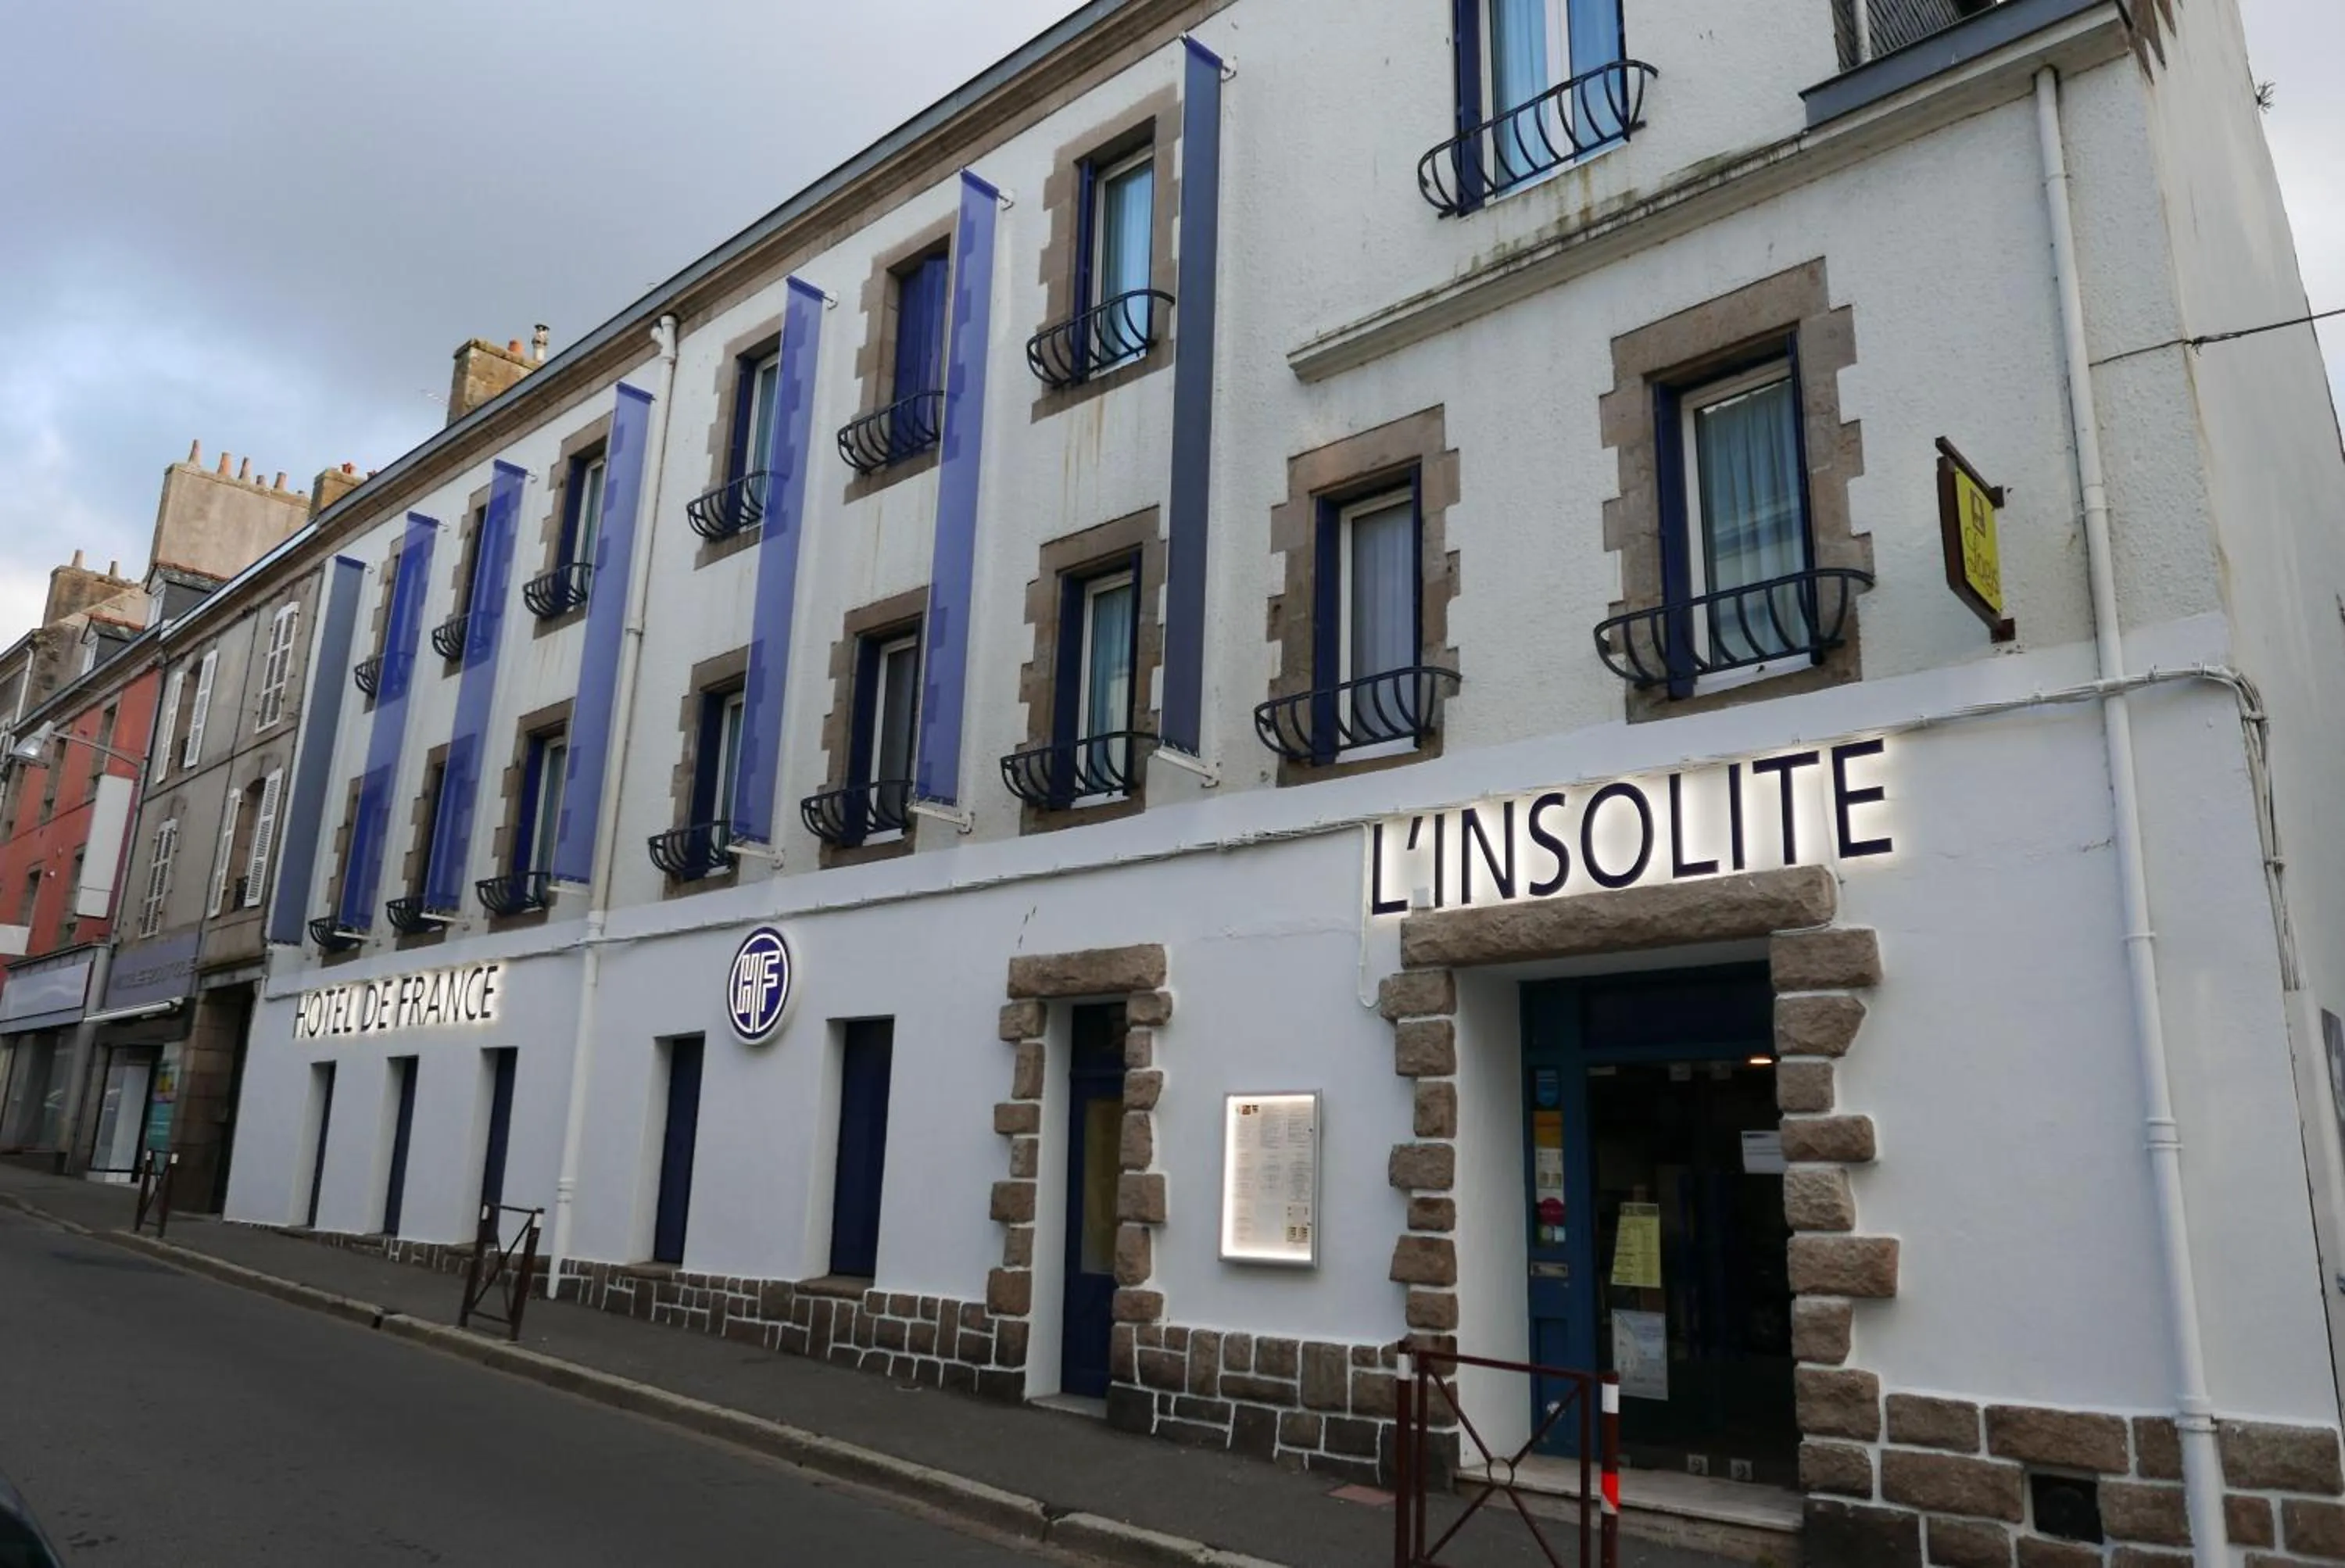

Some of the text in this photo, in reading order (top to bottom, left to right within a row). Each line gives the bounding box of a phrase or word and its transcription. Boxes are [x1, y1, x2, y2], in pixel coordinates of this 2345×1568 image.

[1372, 738, 1893, 915] L'INSOLITE
[292, 965, 499, 1039] HOTEL DE FRANCE
